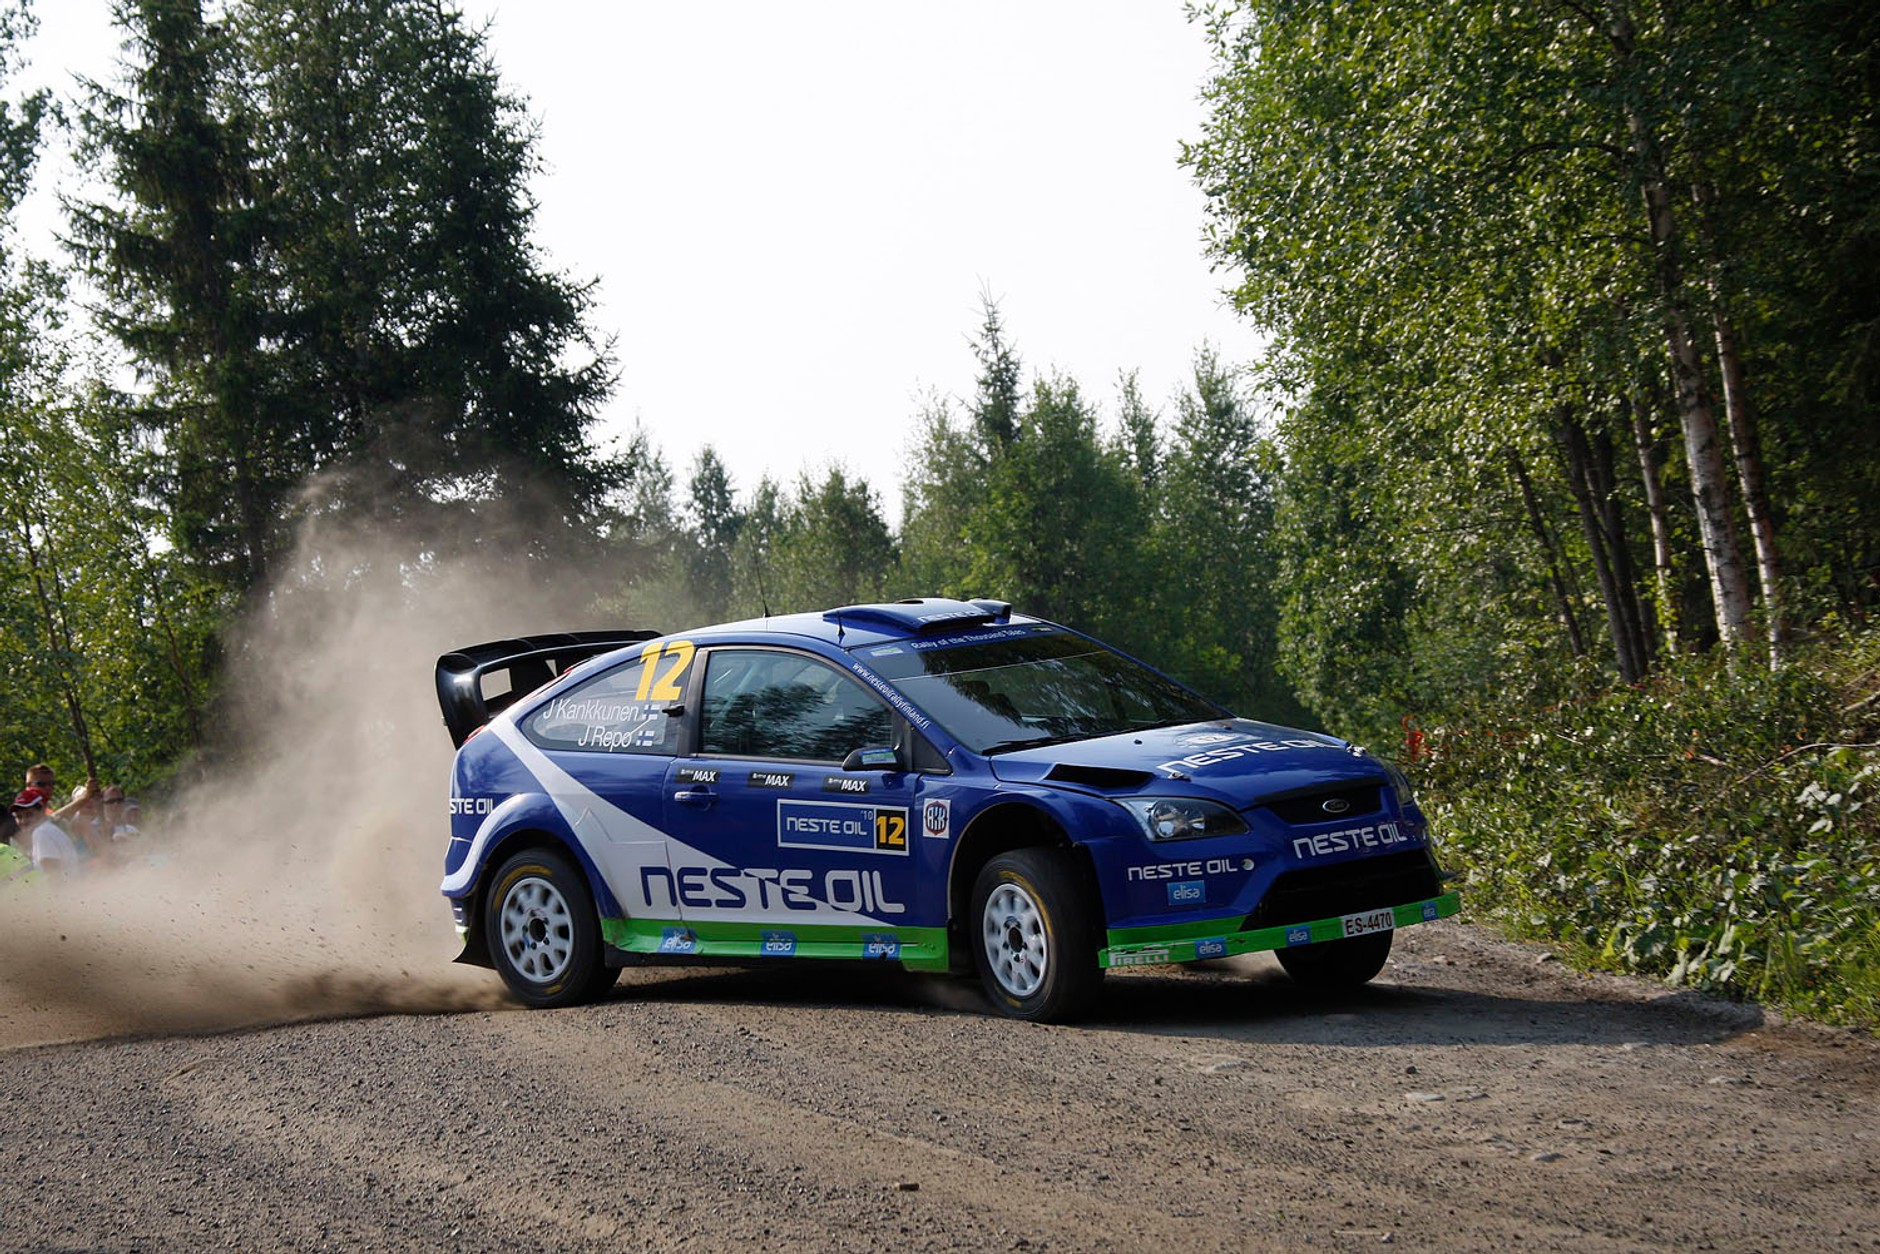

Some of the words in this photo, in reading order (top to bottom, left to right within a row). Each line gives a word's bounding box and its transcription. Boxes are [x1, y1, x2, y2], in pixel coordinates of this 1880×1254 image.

[635, 641, 694, 701] 12
[852, 663, 930, 730] www.nesteoilrallyfinland.fi
[543, 699, 555, 719] J
[556, 700, 639, 721] Kankkunen
[578, 724, 590, 746] J
[591, 726, 632, 752] Repo
[1156, 741, 1290, 774] NESTE
[692, 770, 717, 782] MAX
[765, 774, 790, 787] MAX
[841, 779, 867, 792] MAX
[786, 817, 842, 834] NESTE
[843, 820, 868, 836] OIL
[876, 815, 905, 845] 12
[1293, 825, 1379, 859] NESTE
[1378, 822, 1407, 845] OIL
[1128, 861, 1202, 881] NESTE
[1206, 859, 1238, 874] OIL
[640, 866, 818, 910] NESTE
[824, 869, 906, 914] OIL
[1173, 885, 1200, 900] elisa
[1344, 911, 1393, 936] ES-4470
[1287, 928, 1309, 943] elisa
[1109, 945, 1170, 966] PIRELLI
[1199, 941, 1223, 956] elisa
